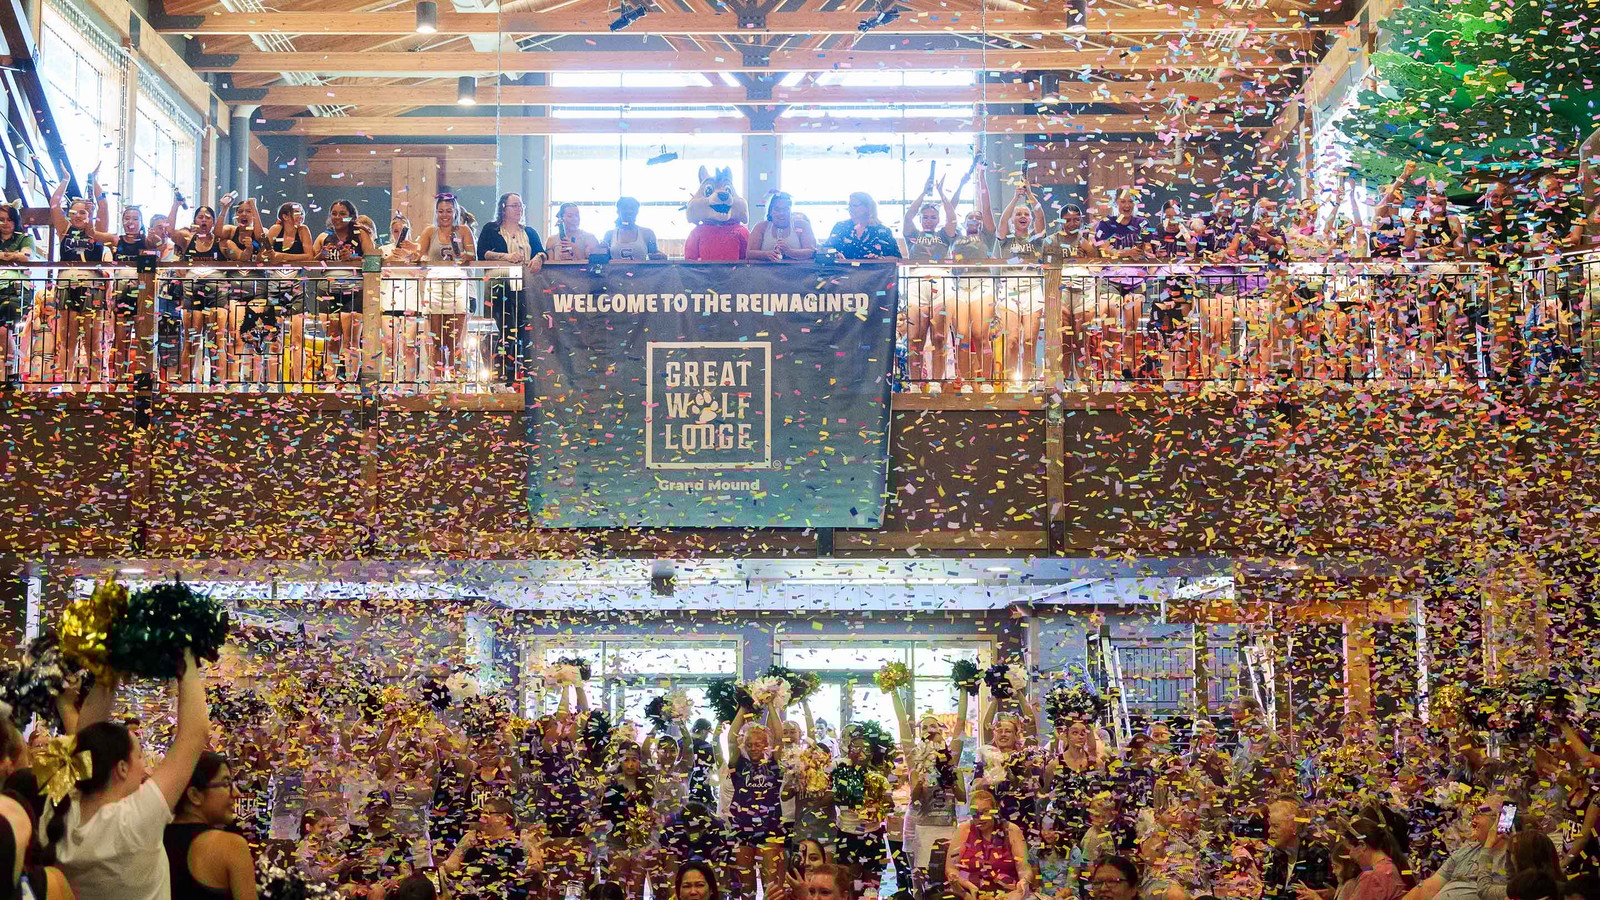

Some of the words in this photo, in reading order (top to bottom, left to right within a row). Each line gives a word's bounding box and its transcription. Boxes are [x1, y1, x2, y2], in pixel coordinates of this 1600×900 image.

[553, 293, 658, 313] WELCOME
[661, 293, 688, 313] TO
[691, 293, 731, 313] THE
[736, 293, 869, 313] REIMAGINED
[665, 361, 752, 387] GREAT
[665, 392, 752, 419] WLF
[665, 423, 752, 450] LODGE
[658, 479, 704, 491] Grand
[708, 479, 760, 491] Mound
